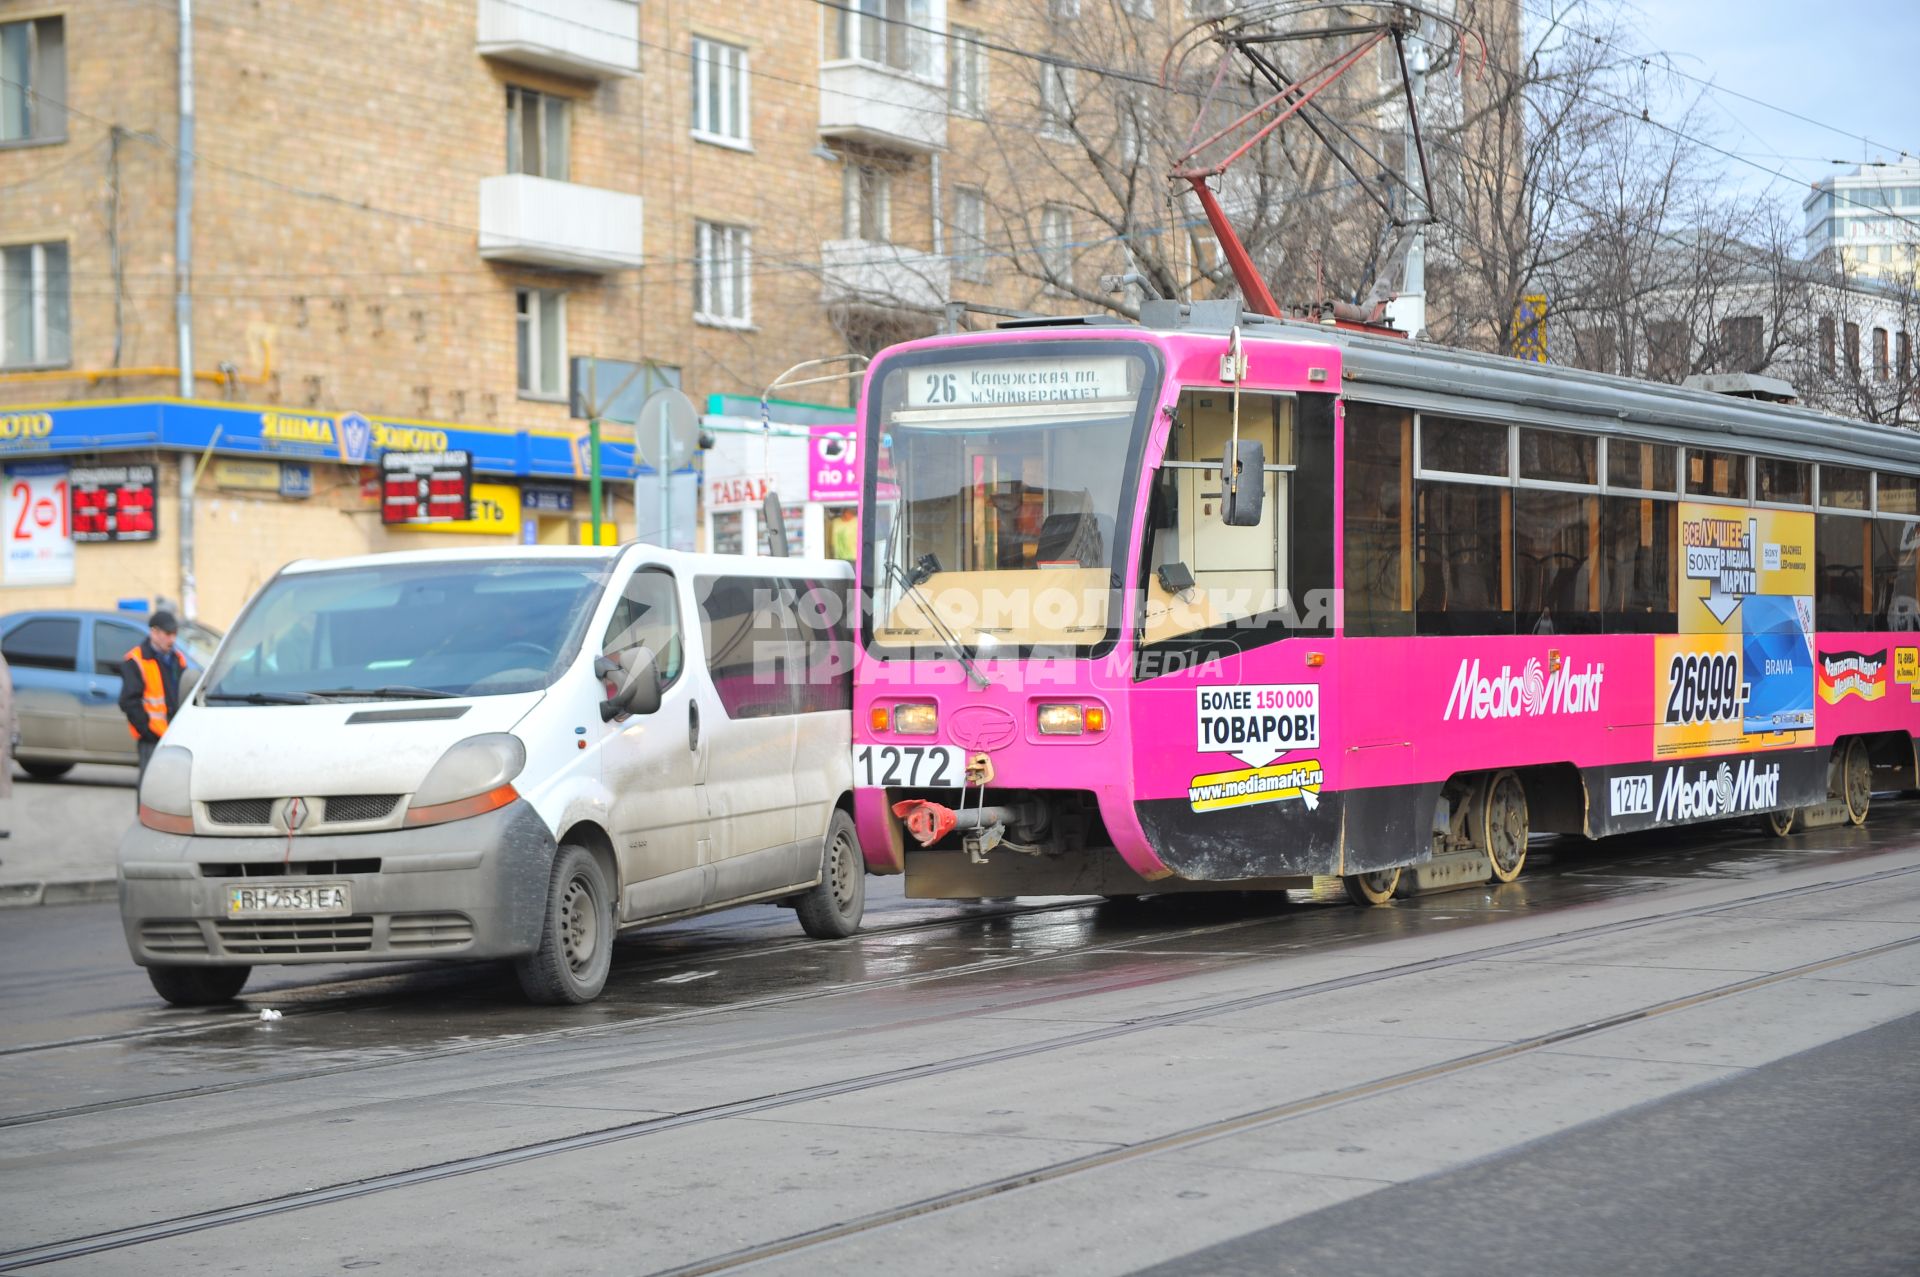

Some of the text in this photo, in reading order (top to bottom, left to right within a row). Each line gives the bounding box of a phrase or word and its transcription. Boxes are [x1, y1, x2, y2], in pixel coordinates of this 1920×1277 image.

[926, 373, 957, 403] 26
[1683, 522, 1700, 547] ВСЕ
[1701, 519, 1743, 549] ЛУЧШЕЕ
[1688, 553, 1719, 571] SONY
[1727, 550, 1749, 570] МЕДИА
[1765, 659, 1793, 676] BRAVIA
[1201, 691, 1252, 710] БОЛЕЕ
[1200, 714, 1315, 744] ТОВАРОВ!
[858, 745, 951, 786] 1272
[1189, 768, 1323, 802] www.mediamarkt.ru
[1617, 778, 1648, 813] 1272
